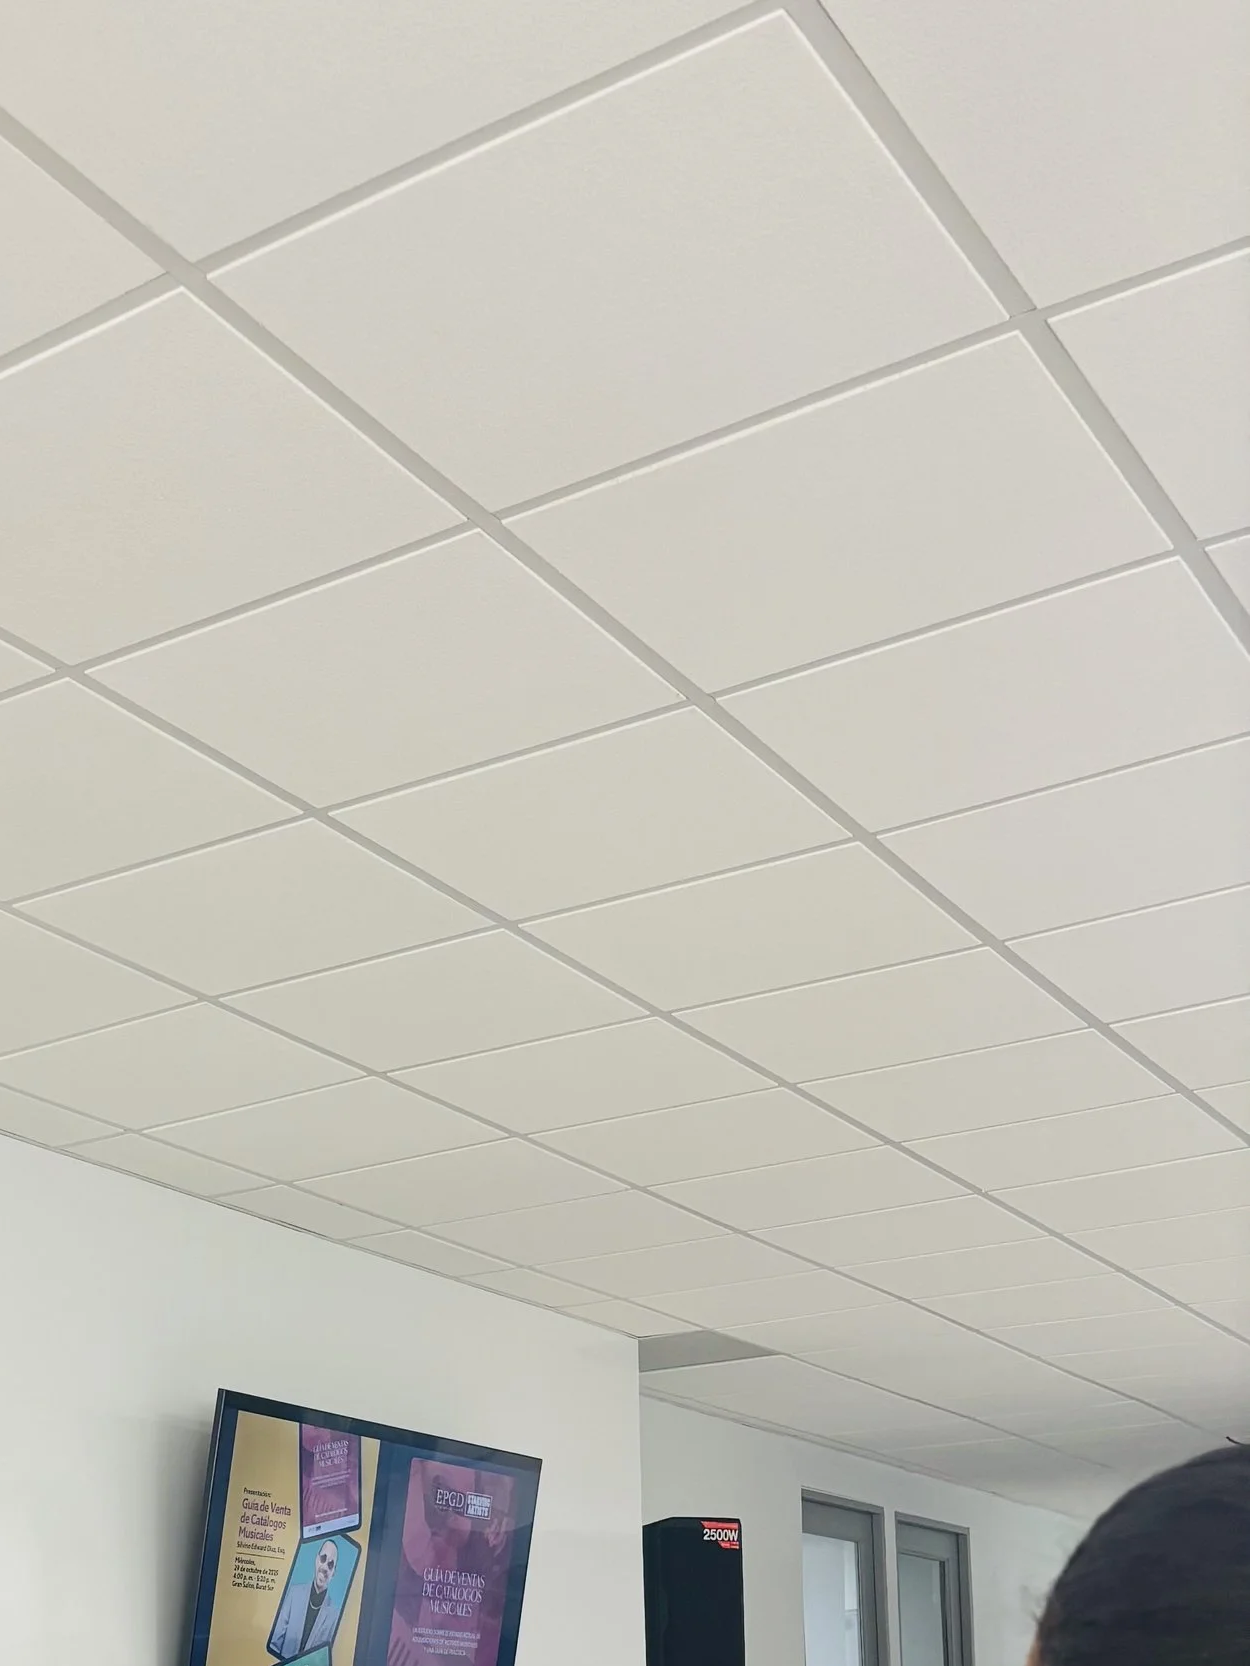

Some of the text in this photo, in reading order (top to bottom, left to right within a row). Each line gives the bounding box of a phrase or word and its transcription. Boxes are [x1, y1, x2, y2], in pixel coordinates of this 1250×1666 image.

[436, 1489, 464, 1508] EPGD
[260, 1500, 269, 1512] de
[270, 1502, 291, 1516] Venta
[240, 1512, 250, 1524] de
[238, 1526, 274, 1541] Musicales
[703, 1529, 739, 1541] 2500W
